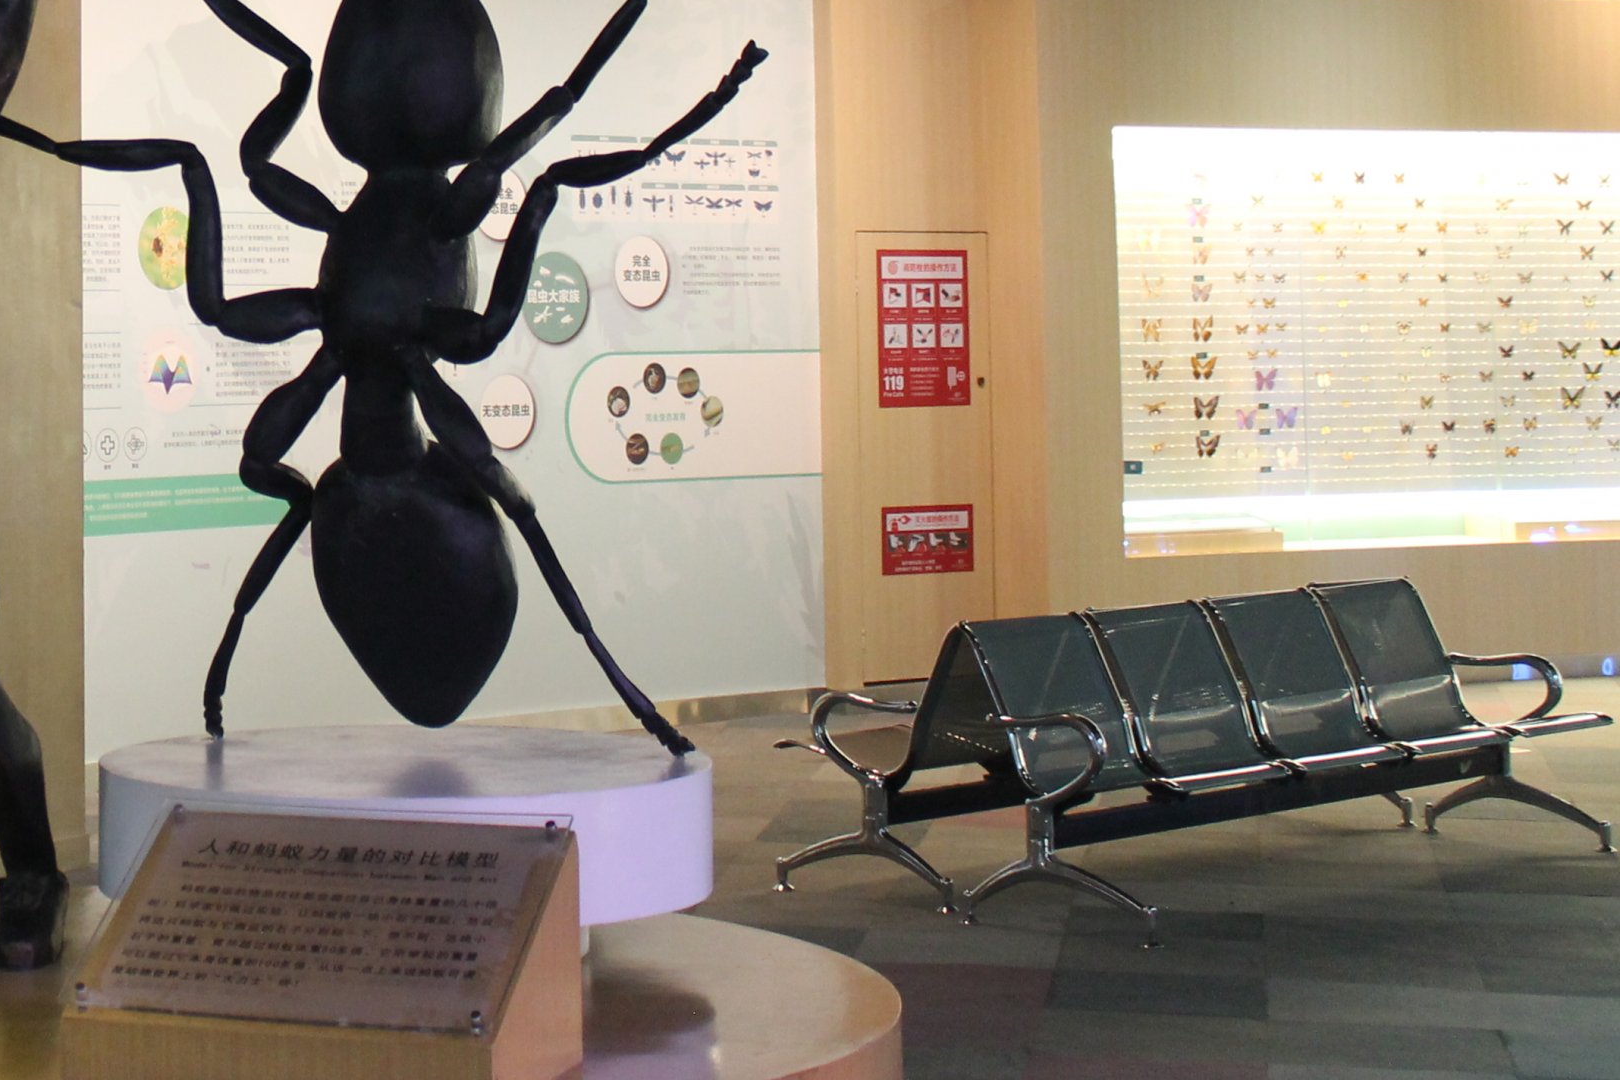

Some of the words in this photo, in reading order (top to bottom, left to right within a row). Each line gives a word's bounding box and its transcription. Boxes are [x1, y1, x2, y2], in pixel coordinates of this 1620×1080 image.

[632, 255, 651, 267] 完全
[624, 270, 661, 282] 变态昆虫
[527, 289, 580, 305] 昆虫大家族
[884, 376, 904, 391] 119
[482, 404, 530, 418] 无变态昆虫
[199, 838, 500, 869] 人和蚂蚁力量的对比模型
